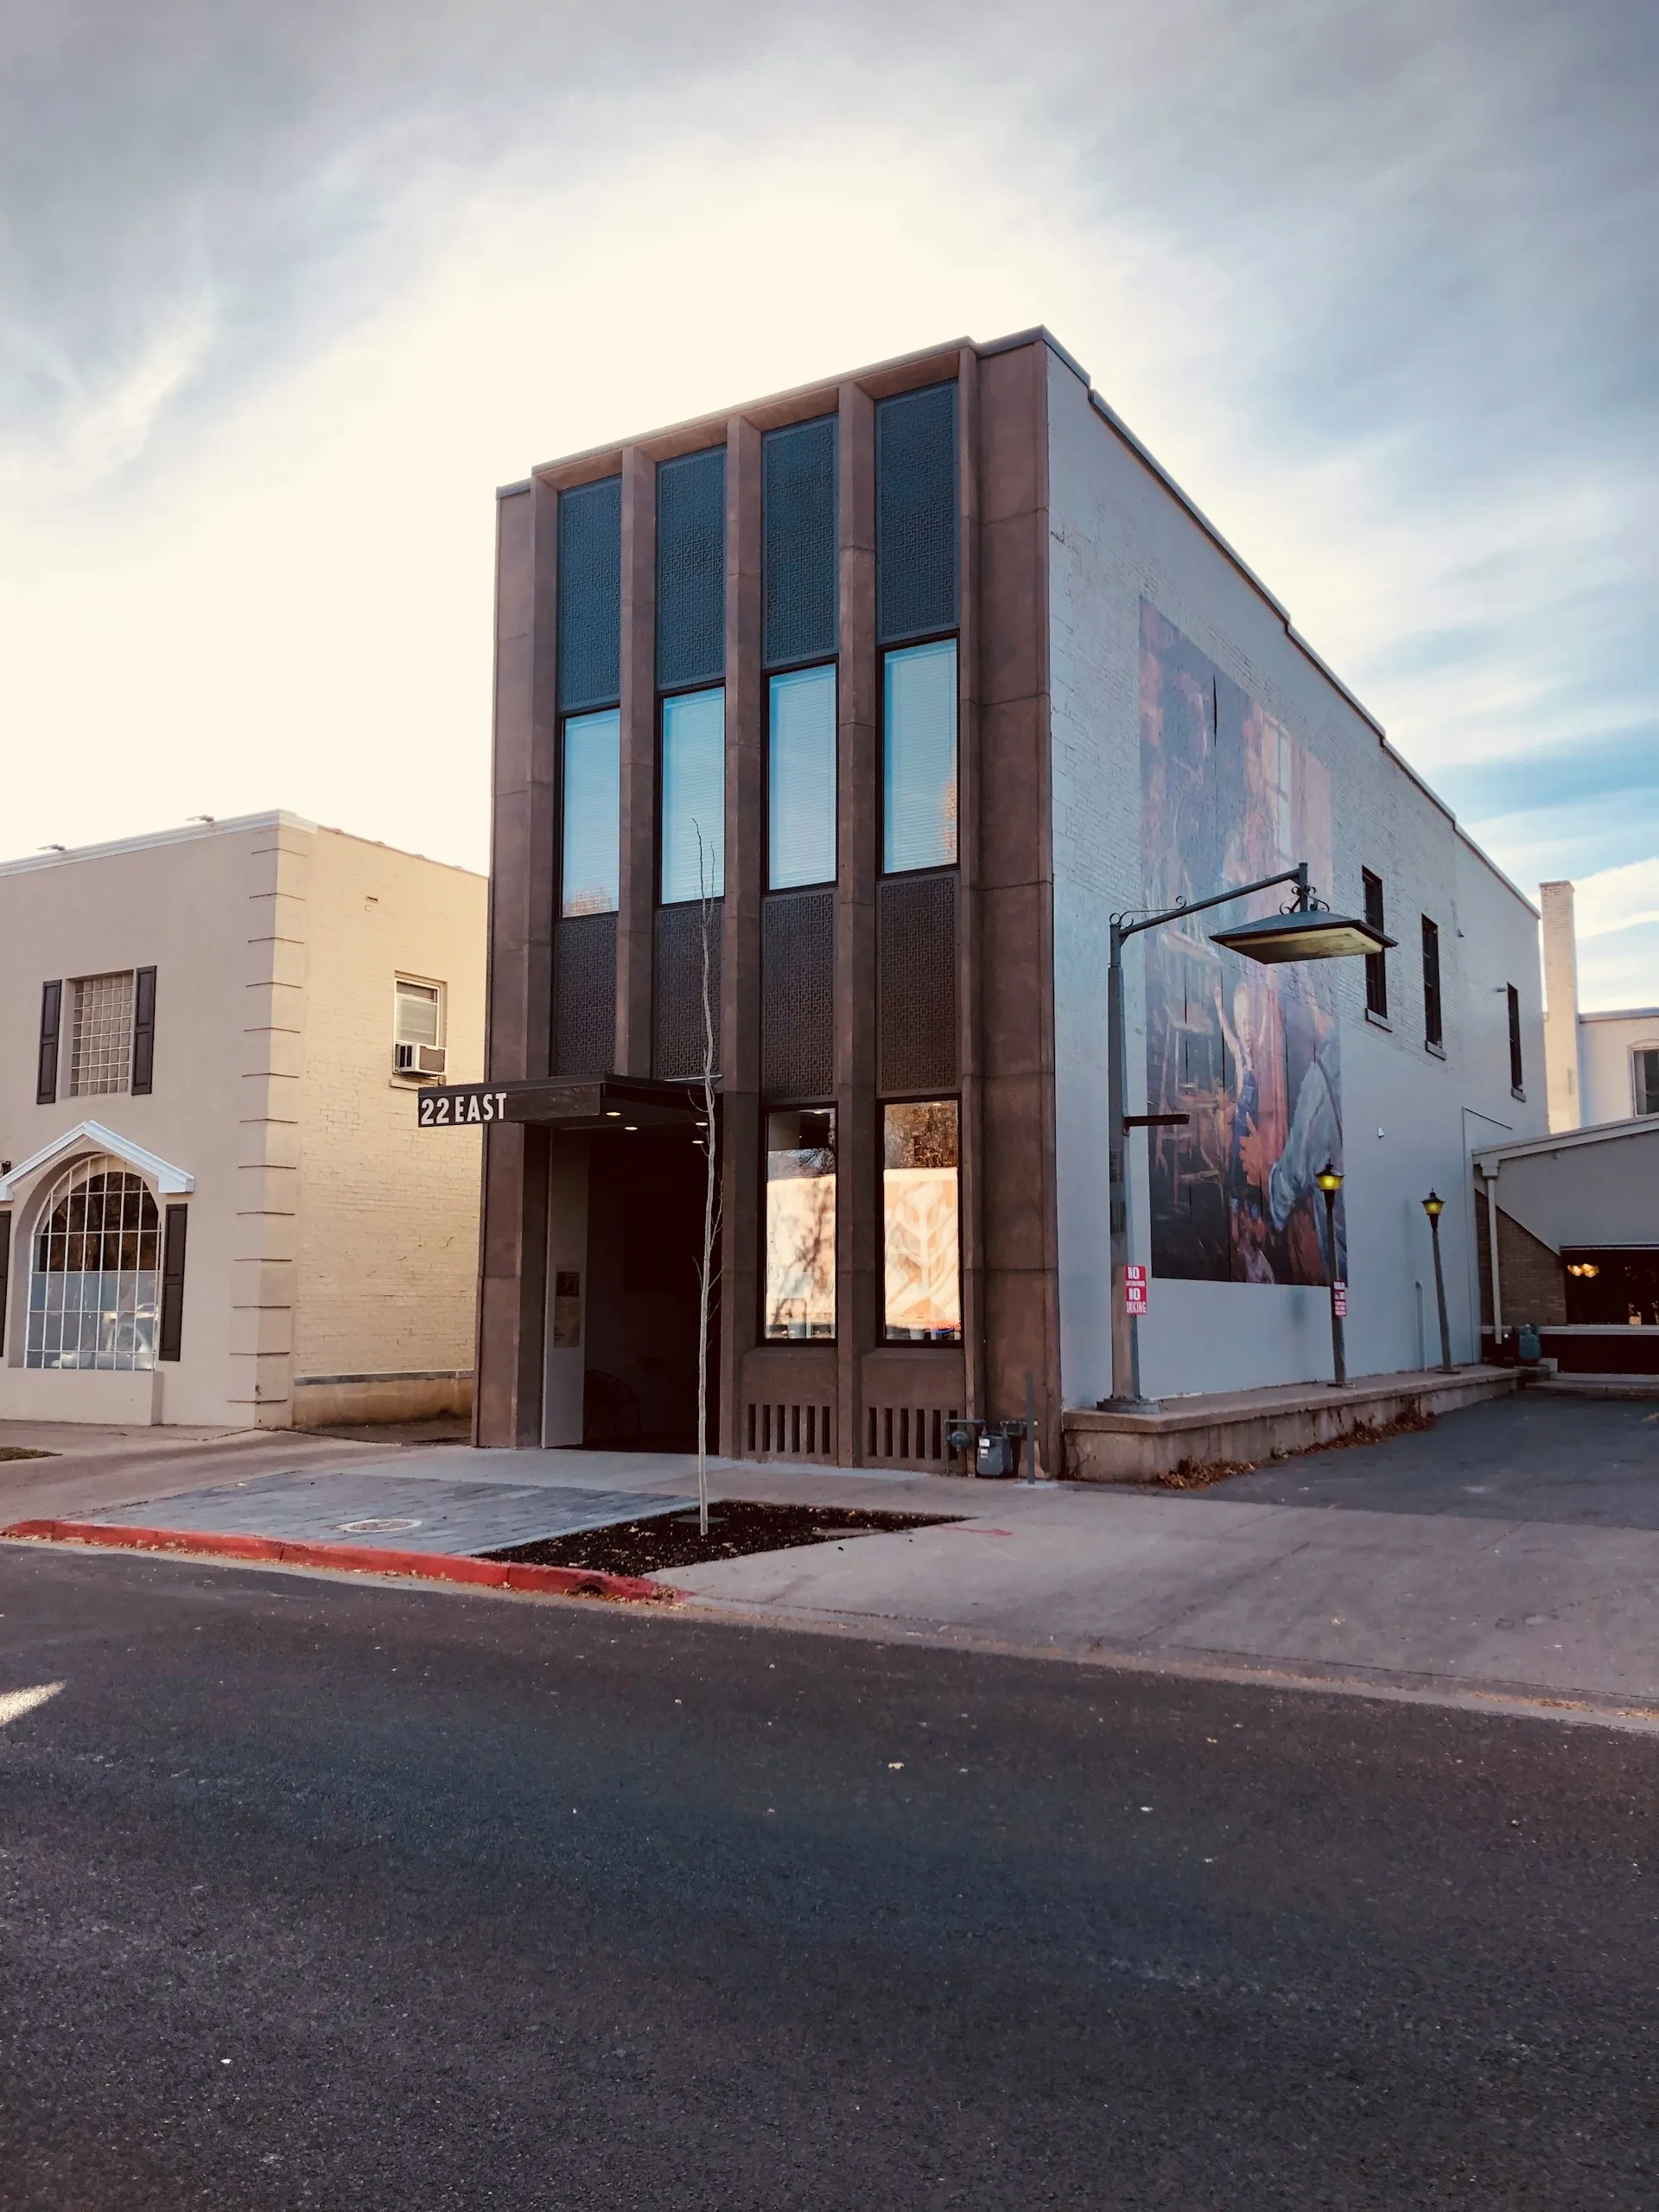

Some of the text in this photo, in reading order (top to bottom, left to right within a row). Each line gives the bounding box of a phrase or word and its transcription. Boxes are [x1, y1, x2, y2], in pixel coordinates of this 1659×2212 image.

[421, 1092, 507, 1125] 22 EAST
[1127, 1266, 1141, 1280] NO
[1128, 1287, 1141, 1300] NO
